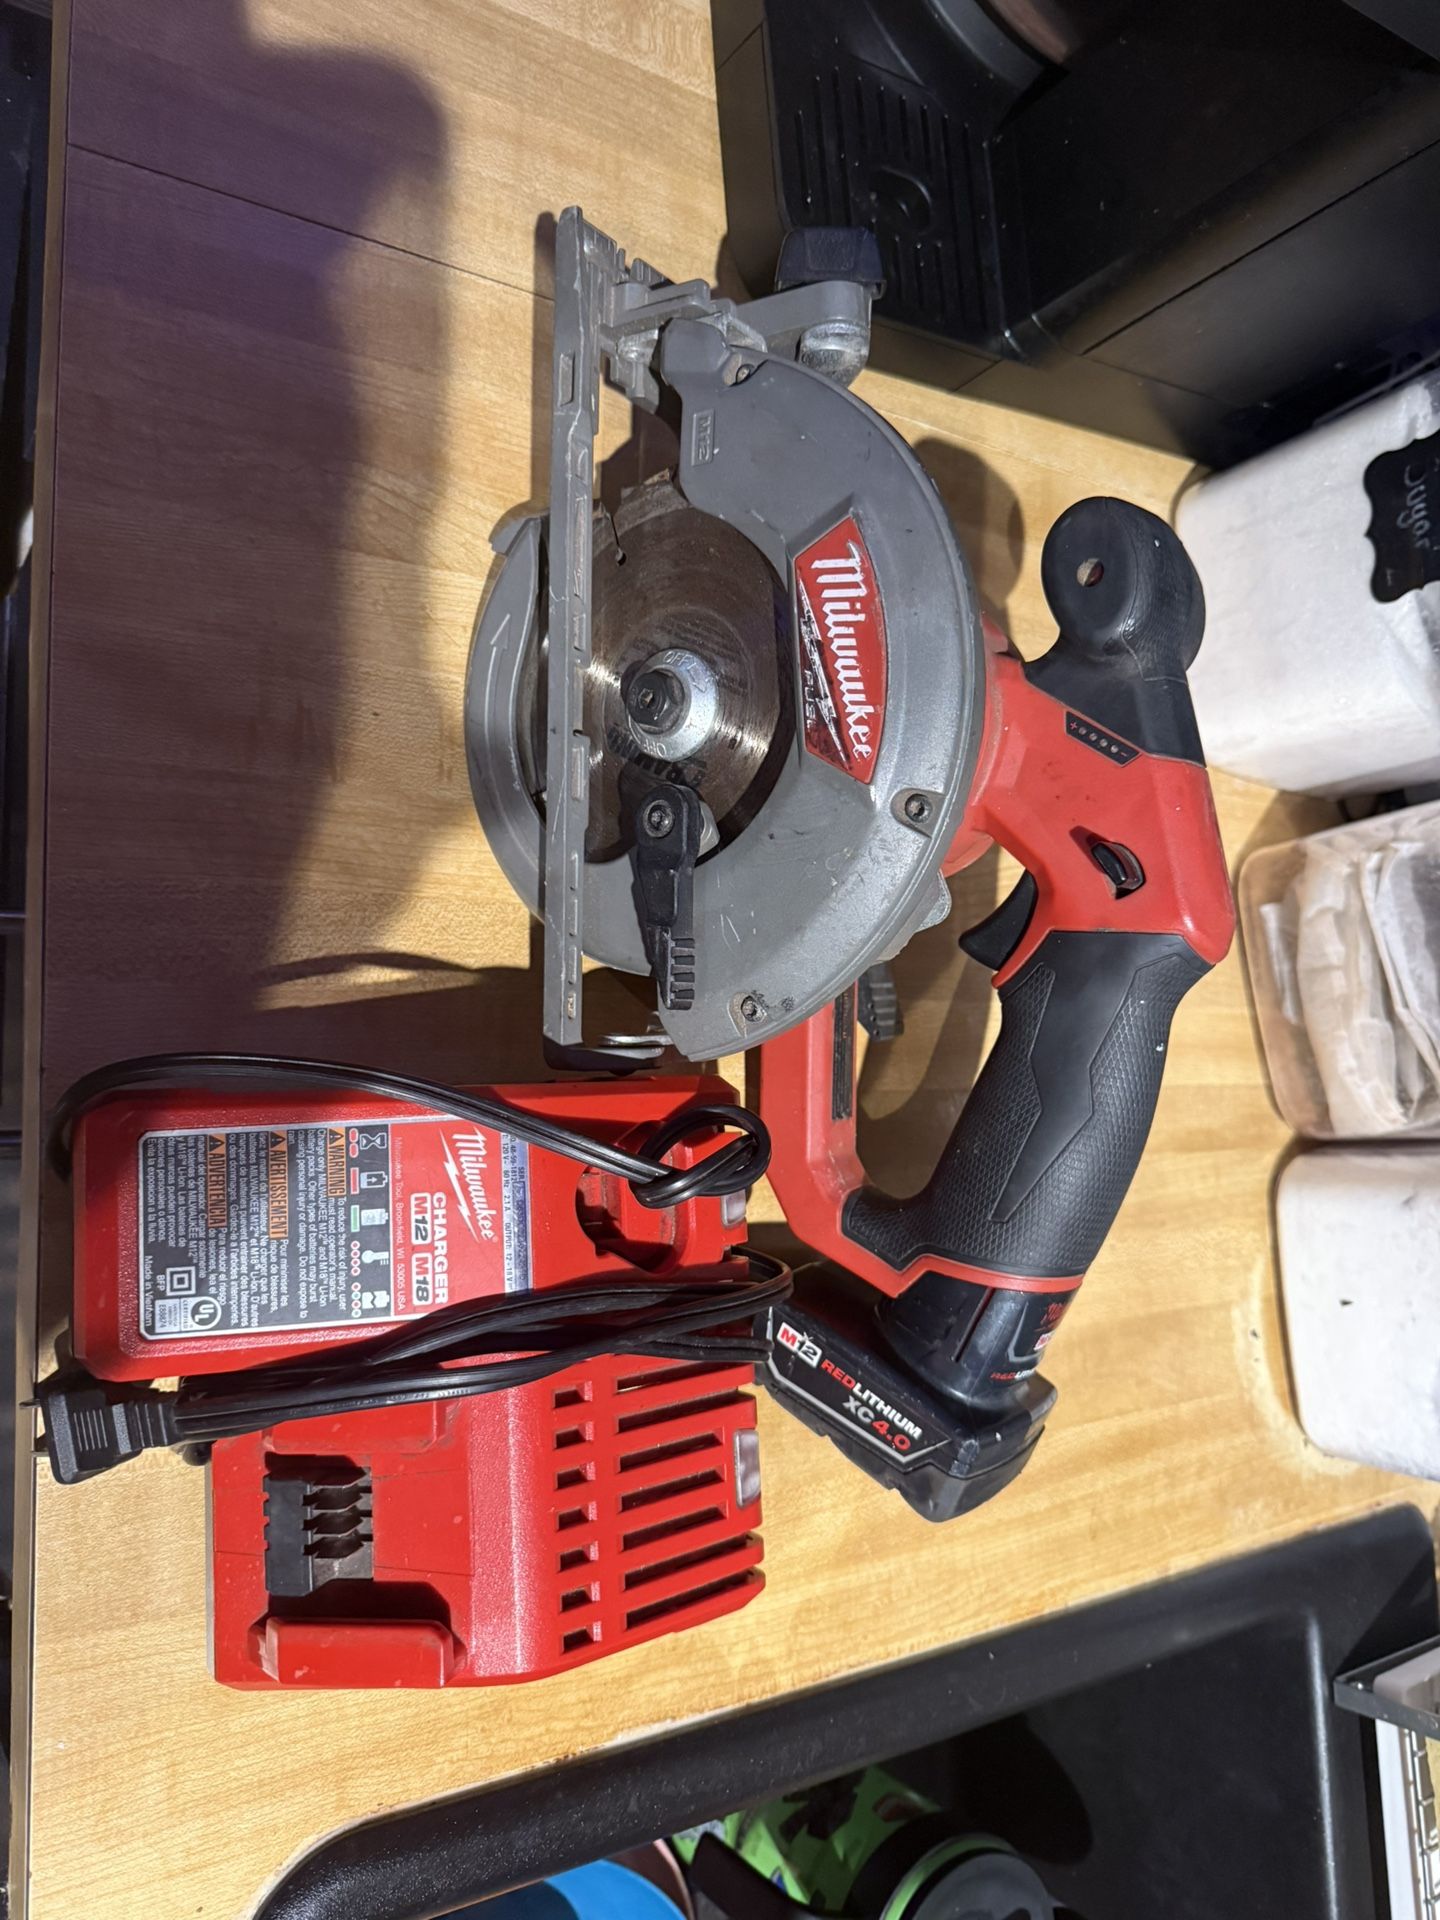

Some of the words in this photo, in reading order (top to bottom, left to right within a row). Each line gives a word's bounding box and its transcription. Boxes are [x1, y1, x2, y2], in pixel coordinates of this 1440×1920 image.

[810, 541, 874, 762] Milwaukee
[148, 1138, 156, 1156] Evite
[168, 1136, 176, 1156] otras
[188, 1136, 196, 1147] las
[198, 1136, 206, 1162] manual
[230, 1134, 236, 1143] ou
[238, 1134, 248, 1165] marques
[248, 1133, 258, 1164] batteries
[296, 1130, 306, 1158] causing
[306, 1130, 316, 1154] battery
[316, 1129, 326, 1155] Charge
[157, 1138, 165, 1168] lesiones
[316, 1156, 326, 1172] only
[510, 1144, 518, 1181] 48-59-1812
[198, 1164, 206, 1176] del
[240, 1166, 248, 1176] de
[296, 1160, 306, 1190] personal
[328, 1144, 345, 1195] WARNING
[156, 1169, 166, 1209] personales
[188, 1179, 196, 1189] de
[208, 1153, 226, 1226] ADVERTENCIA
[240, 1178, 248, 1208] batteries
[250, 1165, 258, 1212] MILWAUKEE
[260, 1182, 268, 1192] de
[270, 1150, 287, 1235] AVERTISSEMENT
[308, 1180, 316, 1201] Other
[451, 1126, 497, 1241] Milwaukee
[166, 1186, 176, 1214] pueden
[178, 1191, 186, 1205] Las
[296, 1192, 306, 1211] injury
[318, 1174, 327, 1221] MILWAUKEE
[328, 1197, 336, 1216] must
[338, 1196, 346, 1206] To
[188, 1190, 198, 1239] MILWAUKEE
[230, 1204, 238, 1240] Gardez-le
[307, 1203, 316, 1222] types
[338, 1208, 346, 1232] reduce
[414, 1196, 430, 1241] M12
[166, 1216, 176, 1248] provocar
[198, 1212, 208, 1238] Cargar
[208, 1228, 216, 1238] de
[328, 1217, 336, 1233] read
[178, 1237, 186, 1248] de
[219, 1228, 228, 1246] Para
[250, 1238, 258, 1246] et
[260, 1235, 268, 1246] Ne
[280, 1239, 288, 1256] Pour
[433, 1192, 448, 1304] CHARGER
[198, 1240, 207, 1278] solamente
[219, 1247, 228, 1272] reducir
[268, 1240, 278, 1262] risque
[308, 1233, 318, 1264] batteries
[319, 1246, 328, 1260] and
[327, 1235, 336, 1272] operator's
[338, 1248, 347, 1259] risk
[144, 1256, 153, 1280] Made
[258, 1248, 269, 1276] charger
[270, 1264, 278, 1274] de
[300, 1256, 308, 1267] Do
[156, 1274, 165, 1291] BFP
[209, 1274, 217, 1286] lea
[219, 1274, 228, 1282] el
[240, 1275, 248, 1289] des
[258, 1277, 268, 1292] que
[280, 1258, 289, 1294] minimiser
[300, 1269, 308, 1280] not
[307, 1266, 316, 1282] may
[415, 1256, 430, 1302] M18
[146, 1282, 153, 1290] in
[217, 1282, 227, 1306] riesgo
[298, 1282, 307, 1309] expose
[310, 1284, 318, 1302] burst
[240, 1290, 249, 1326] blessures
[260, 1294, 269, 1304] les
[280, 1295, 289, 1306] les
[398, 1290, 406, 1310] USA
[300, 1310, 308, 1318] to
[779, 1326, 819, 1362] M12
[821, 1359, 923, 1440] REDLITHIUM
